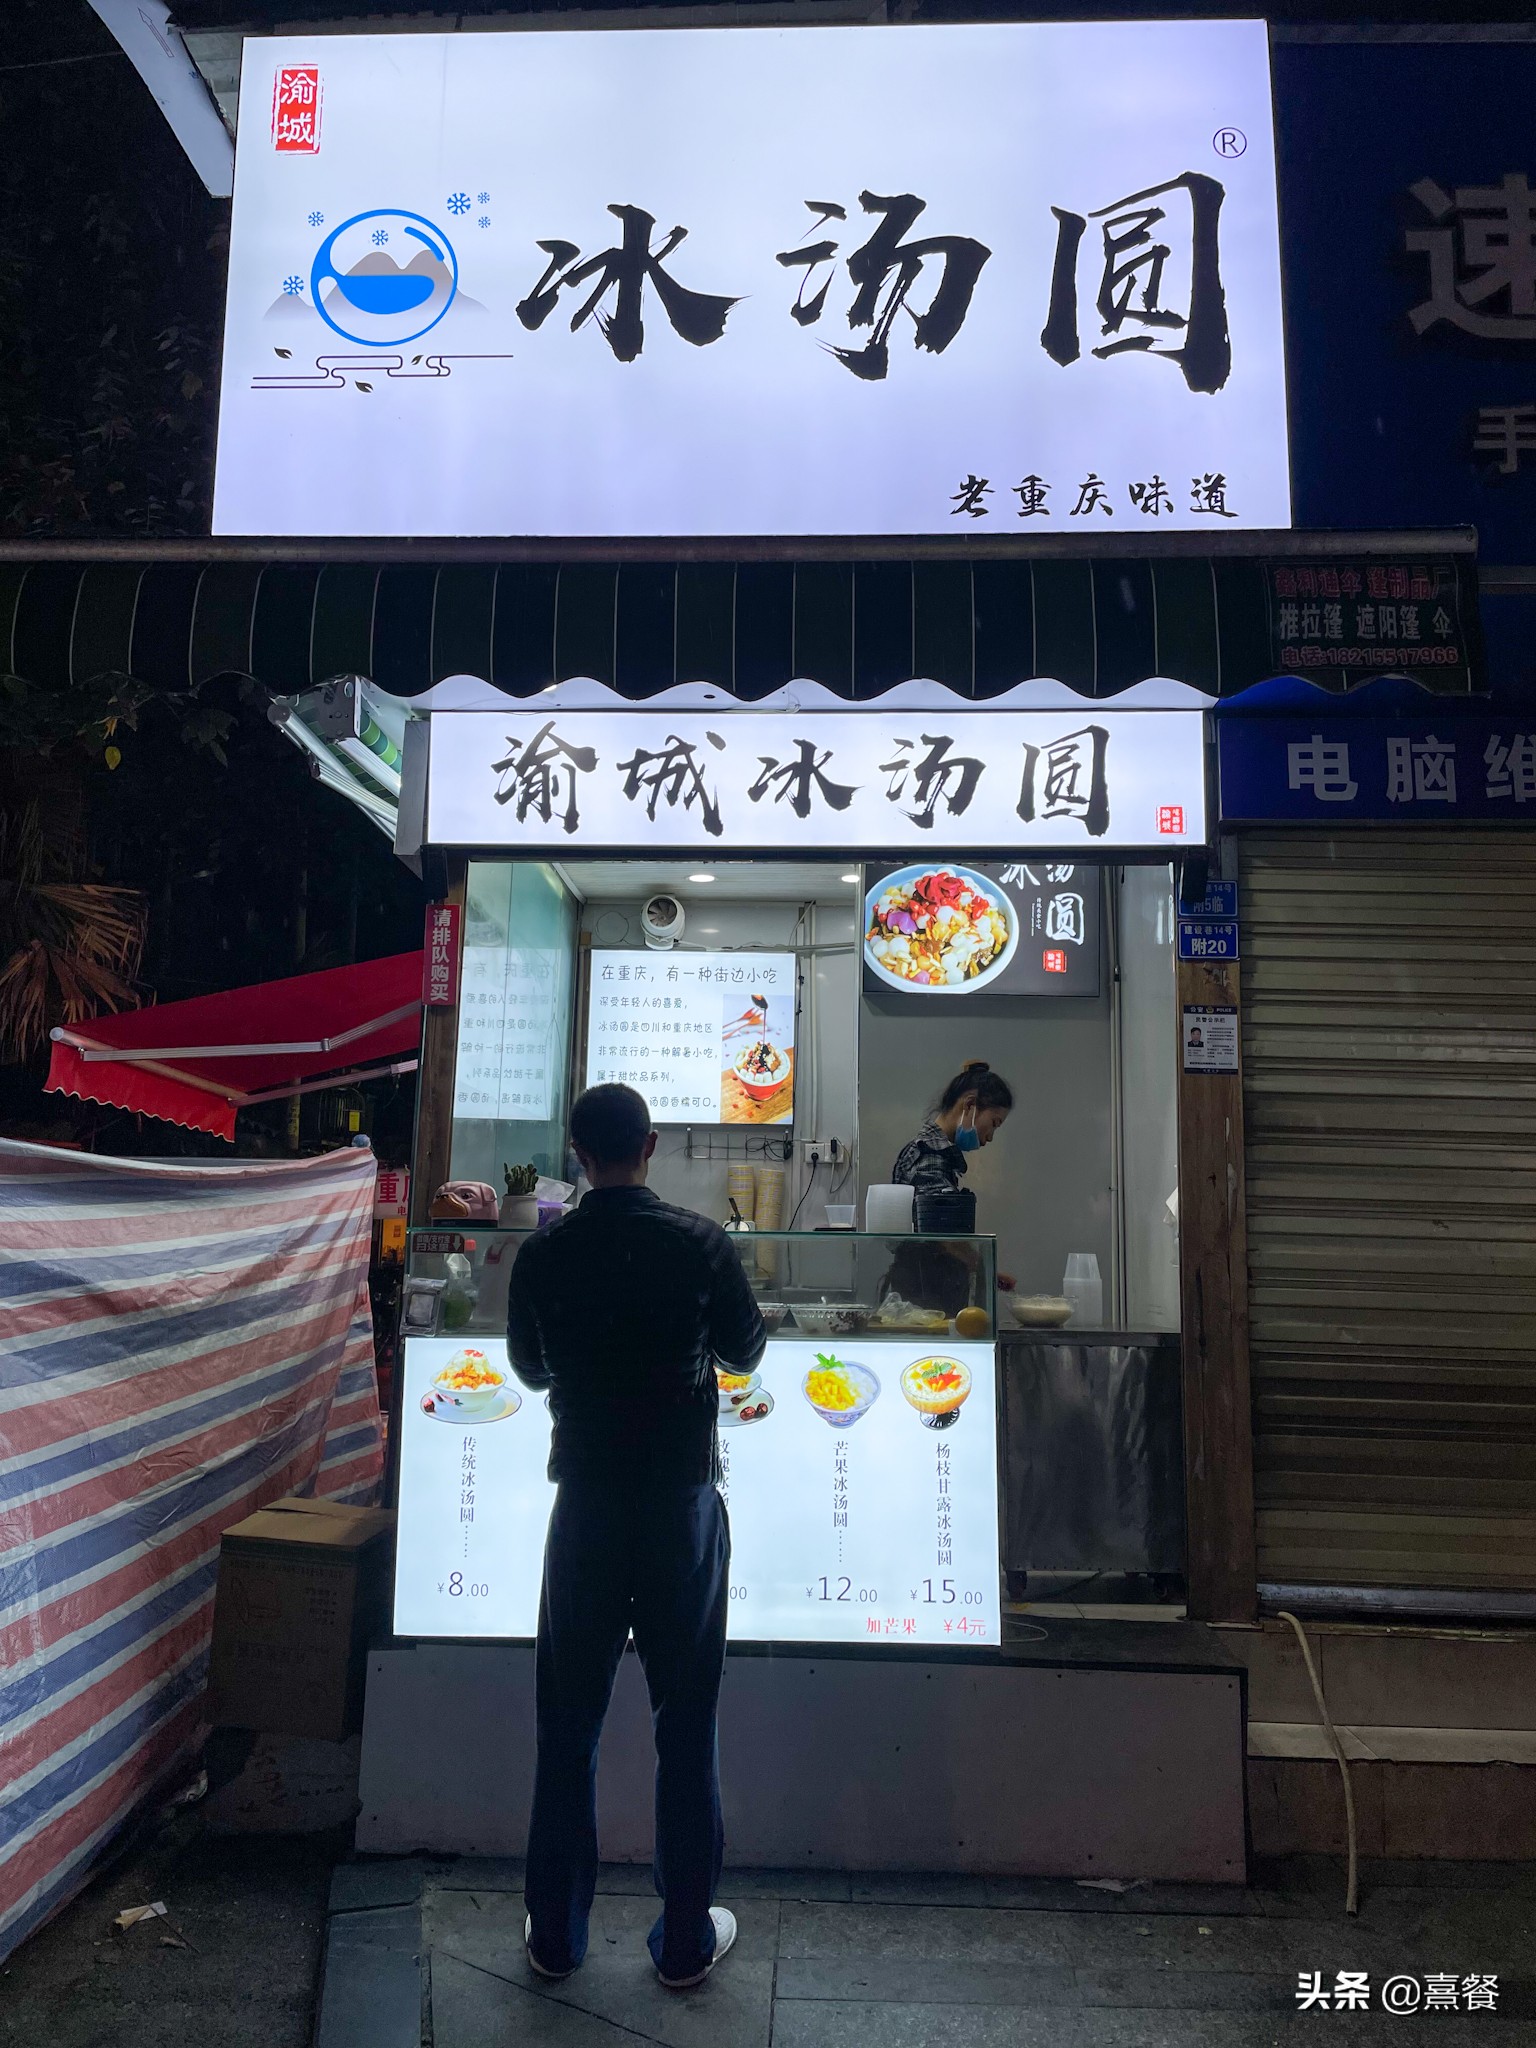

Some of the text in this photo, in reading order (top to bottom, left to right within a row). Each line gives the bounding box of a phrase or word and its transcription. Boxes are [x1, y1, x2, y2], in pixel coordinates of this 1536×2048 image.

[279, 71, 317, 145] 渝城
[1405, 173, 1536, 339] 速
[515, 171, 1232, 395] 冰汤圆
[1473, 406, 1536, 472] 手
[950, 474, 1239, 518] 老重庆味道
[1280, 602, 1454, 640] 推拉篷 遮阳篷 伞
[490, 720, 1111, 837] 渝城冰汤圆
[1288, 734, 1536, 803] 电脑维
[1045, 893, 1085, 946] 圆
[1184, 925, 1233, 935] 建设巷14号
[430, 908, 452, 1002] 请排队购买
[1191, 938, 1227, 955] 附20
[601, 964, 777, 985] 在重庆，有一种街边小吃
[599, 996, 688, 1009] 深受年轻人的喜爱，
[598, 1021, 713, 1033] 冰汤圆是四川和重庆地区
[936, 1442, 952, 1567] 杨枝甘露冰汤圆
[437, 1570, 489, 1598] ¥8.00
[806, 1575, 878, 1604] ¥12.00
[910, 1577, 983, 1606] ¥15.00
[865, 1616, 987, 1636] 加芒果 ¥4元
